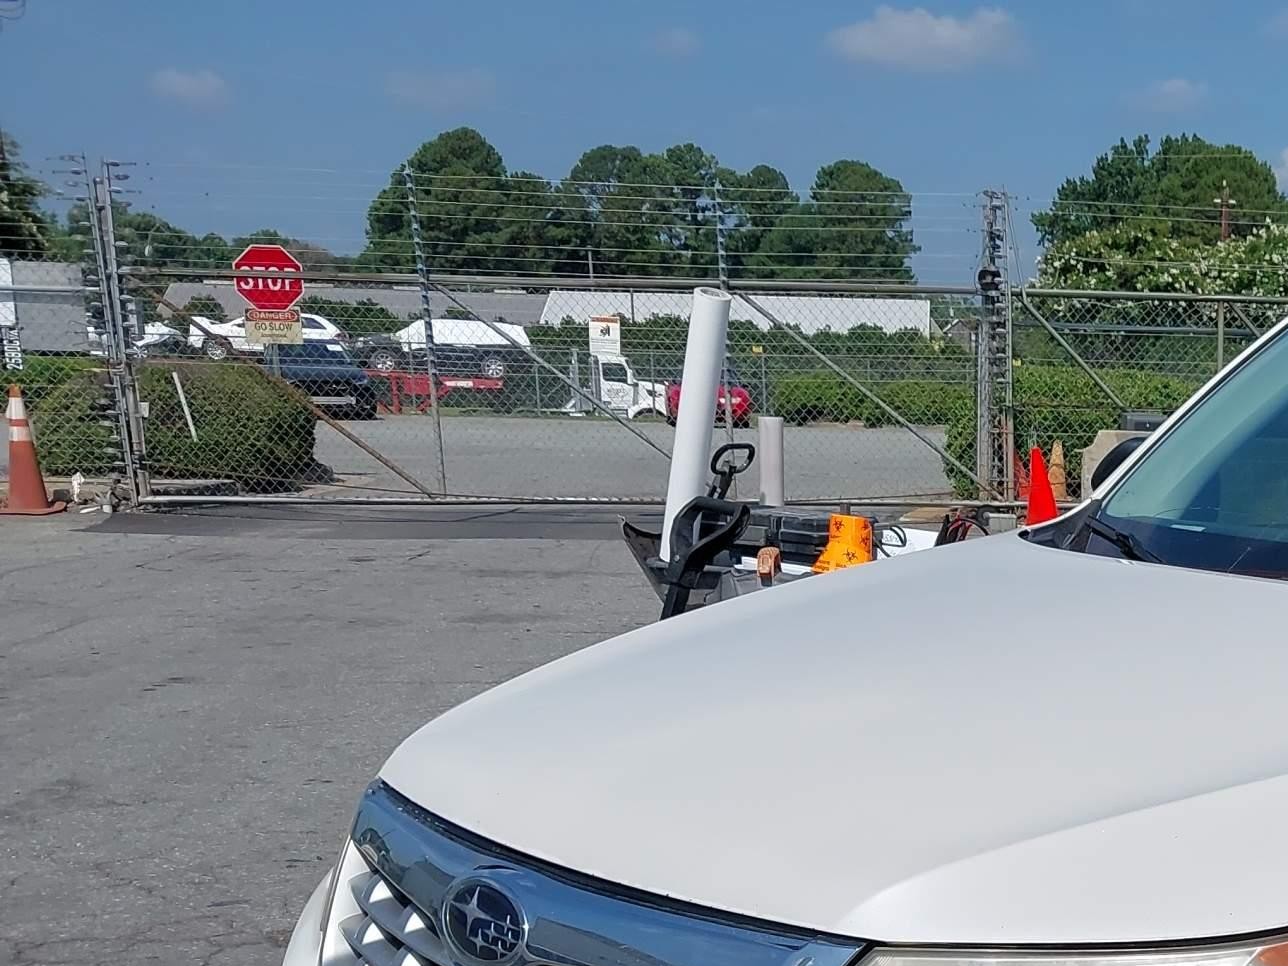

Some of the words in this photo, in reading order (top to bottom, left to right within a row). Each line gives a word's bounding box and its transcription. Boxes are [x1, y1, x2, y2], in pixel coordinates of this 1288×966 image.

[240, 266, 297, 291] STOP
[252, 311, 291, 319] DANGER
[254, 322, 267, 331] GO
[268, 322, 293, 331] SLOW
